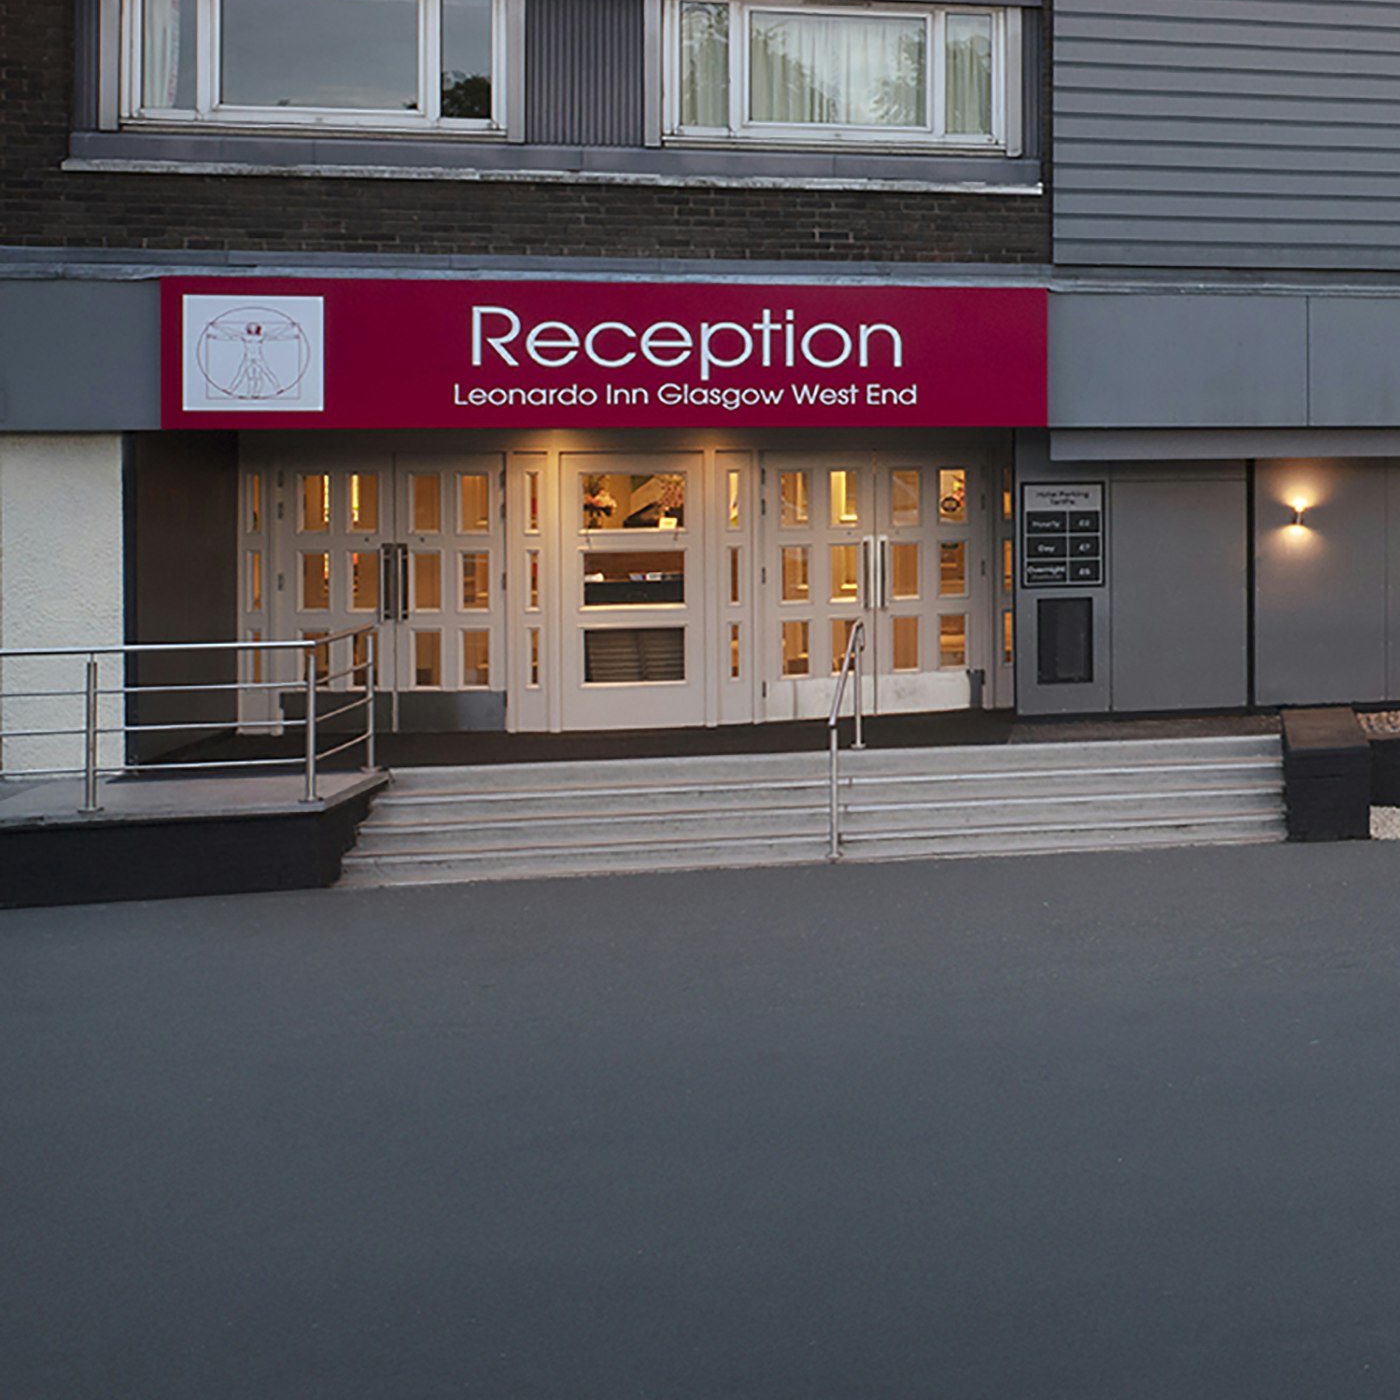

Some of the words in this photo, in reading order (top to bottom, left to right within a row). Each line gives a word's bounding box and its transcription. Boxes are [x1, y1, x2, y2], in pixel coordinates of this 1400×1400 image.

[471, 305, 903, 381] Reception
[454, 383, 598, 406] Leonardo
[606, 383, 649, 405] Inn
[657, 382, 785, 411] Glasgow
[791, 383, 859, 406] West
[866, 383, 917, 406] End
